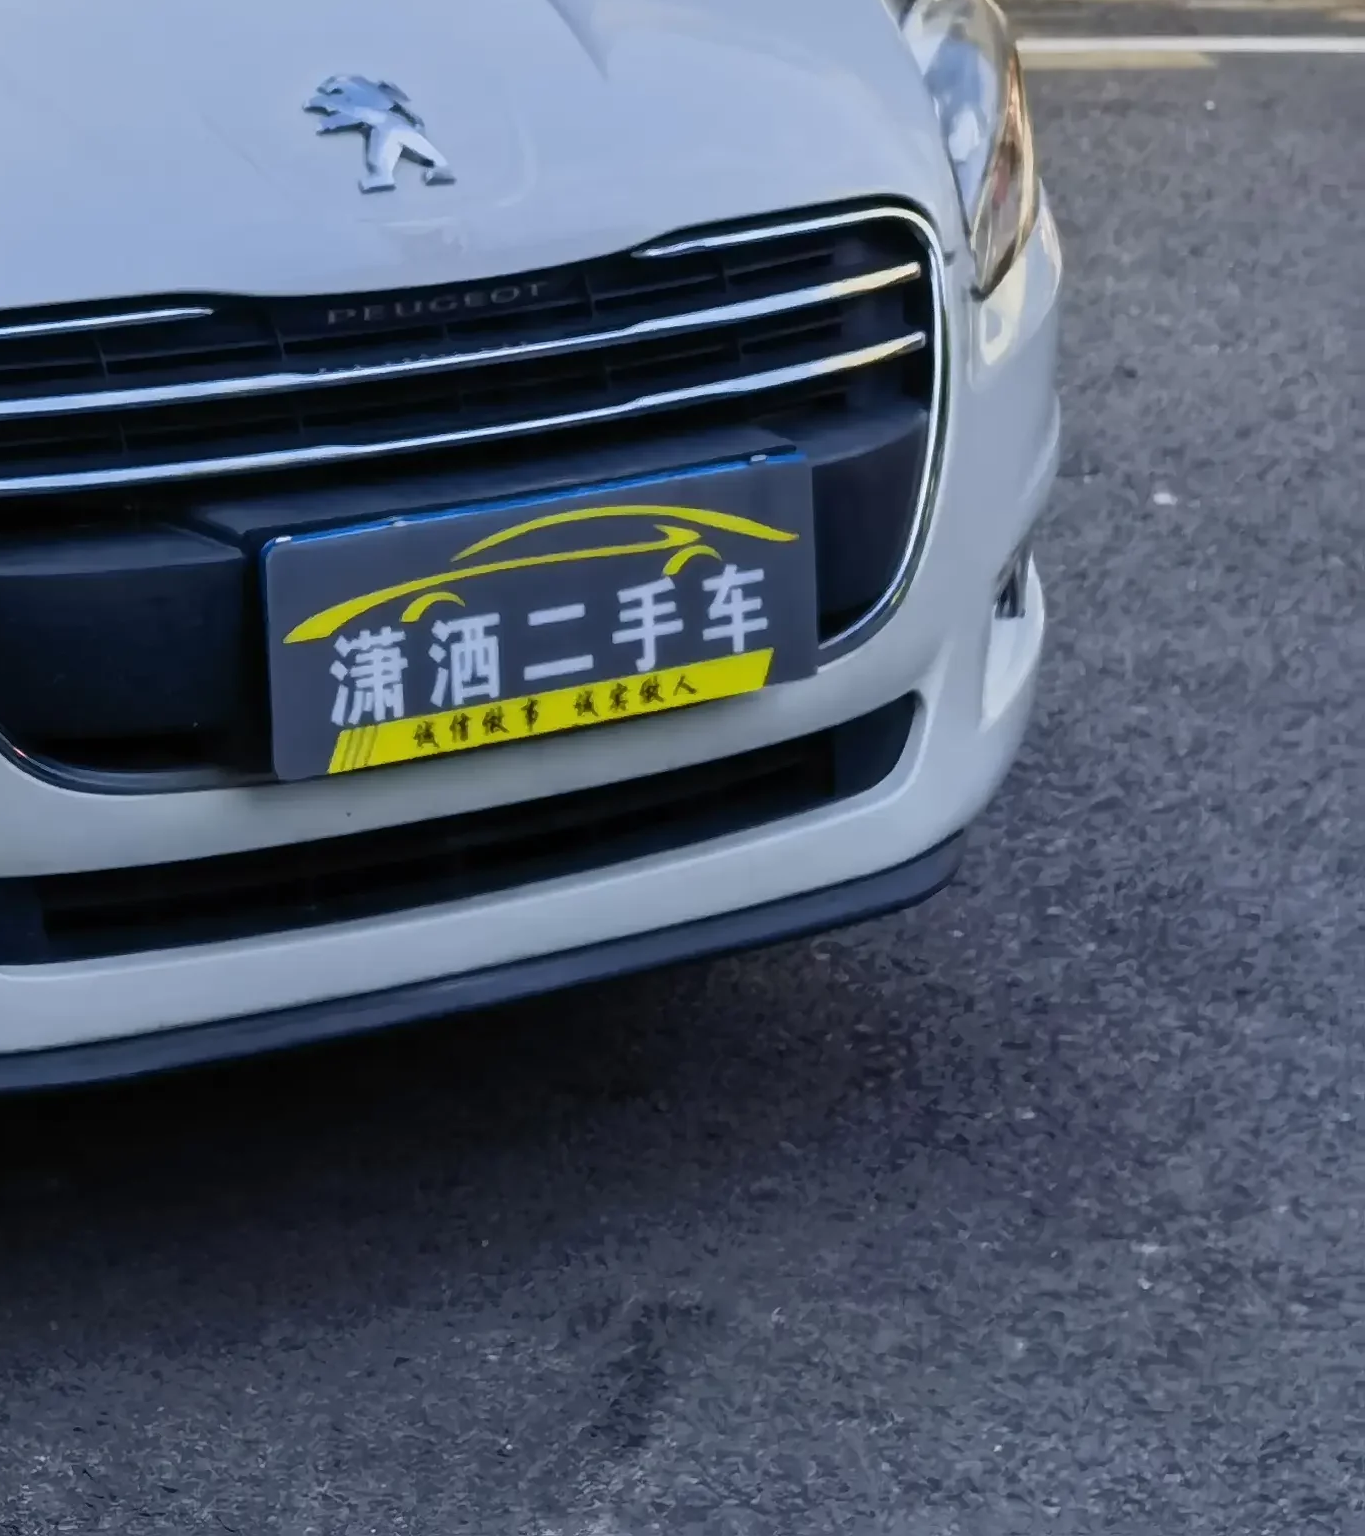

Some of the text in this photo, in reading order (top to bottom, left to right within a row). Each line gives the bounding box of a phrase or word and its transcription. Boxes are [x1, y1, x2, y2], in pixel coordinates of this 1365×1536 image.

[327, 281, 549, 325] PEUGEOT
[329, 564, 769, 726] 潇洒二手车
[413, 673, 699, 750] 诚信做事 诚实做人
